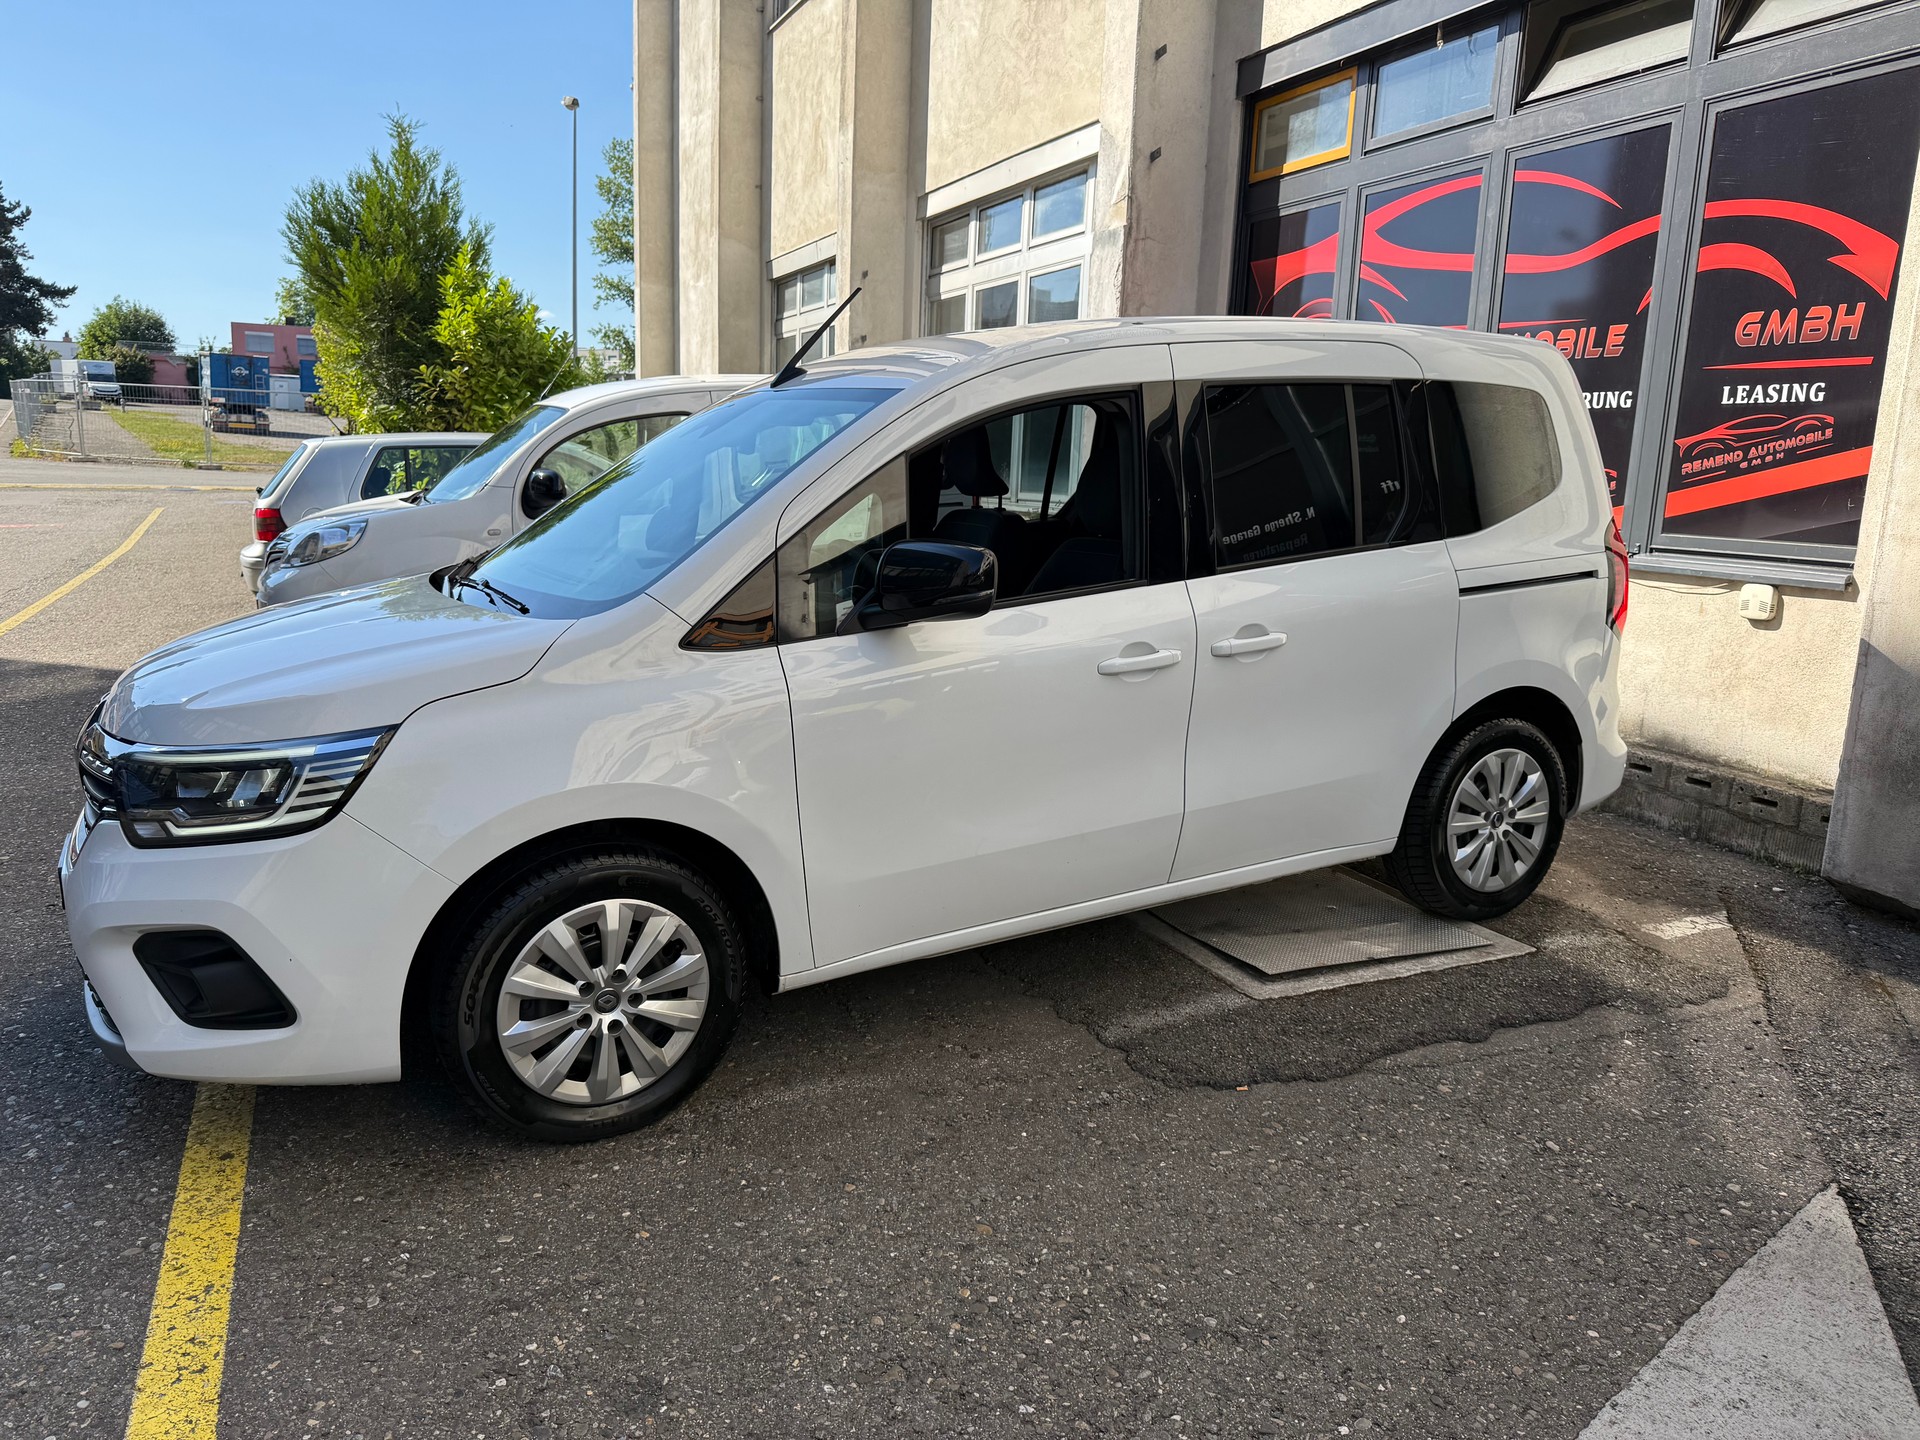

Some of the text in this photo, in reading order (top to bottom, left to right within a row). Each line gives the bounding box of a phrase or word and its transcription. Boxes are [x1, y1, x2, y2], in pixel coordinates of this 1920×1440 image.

[1735, 302, 1866, 347] GMBH
[1721, 382, 1826, 404] LEASING
[1681, 427, 1833, 475] REMEND AUTOMOBILE
[697, 896, 733, 949] 205/60
